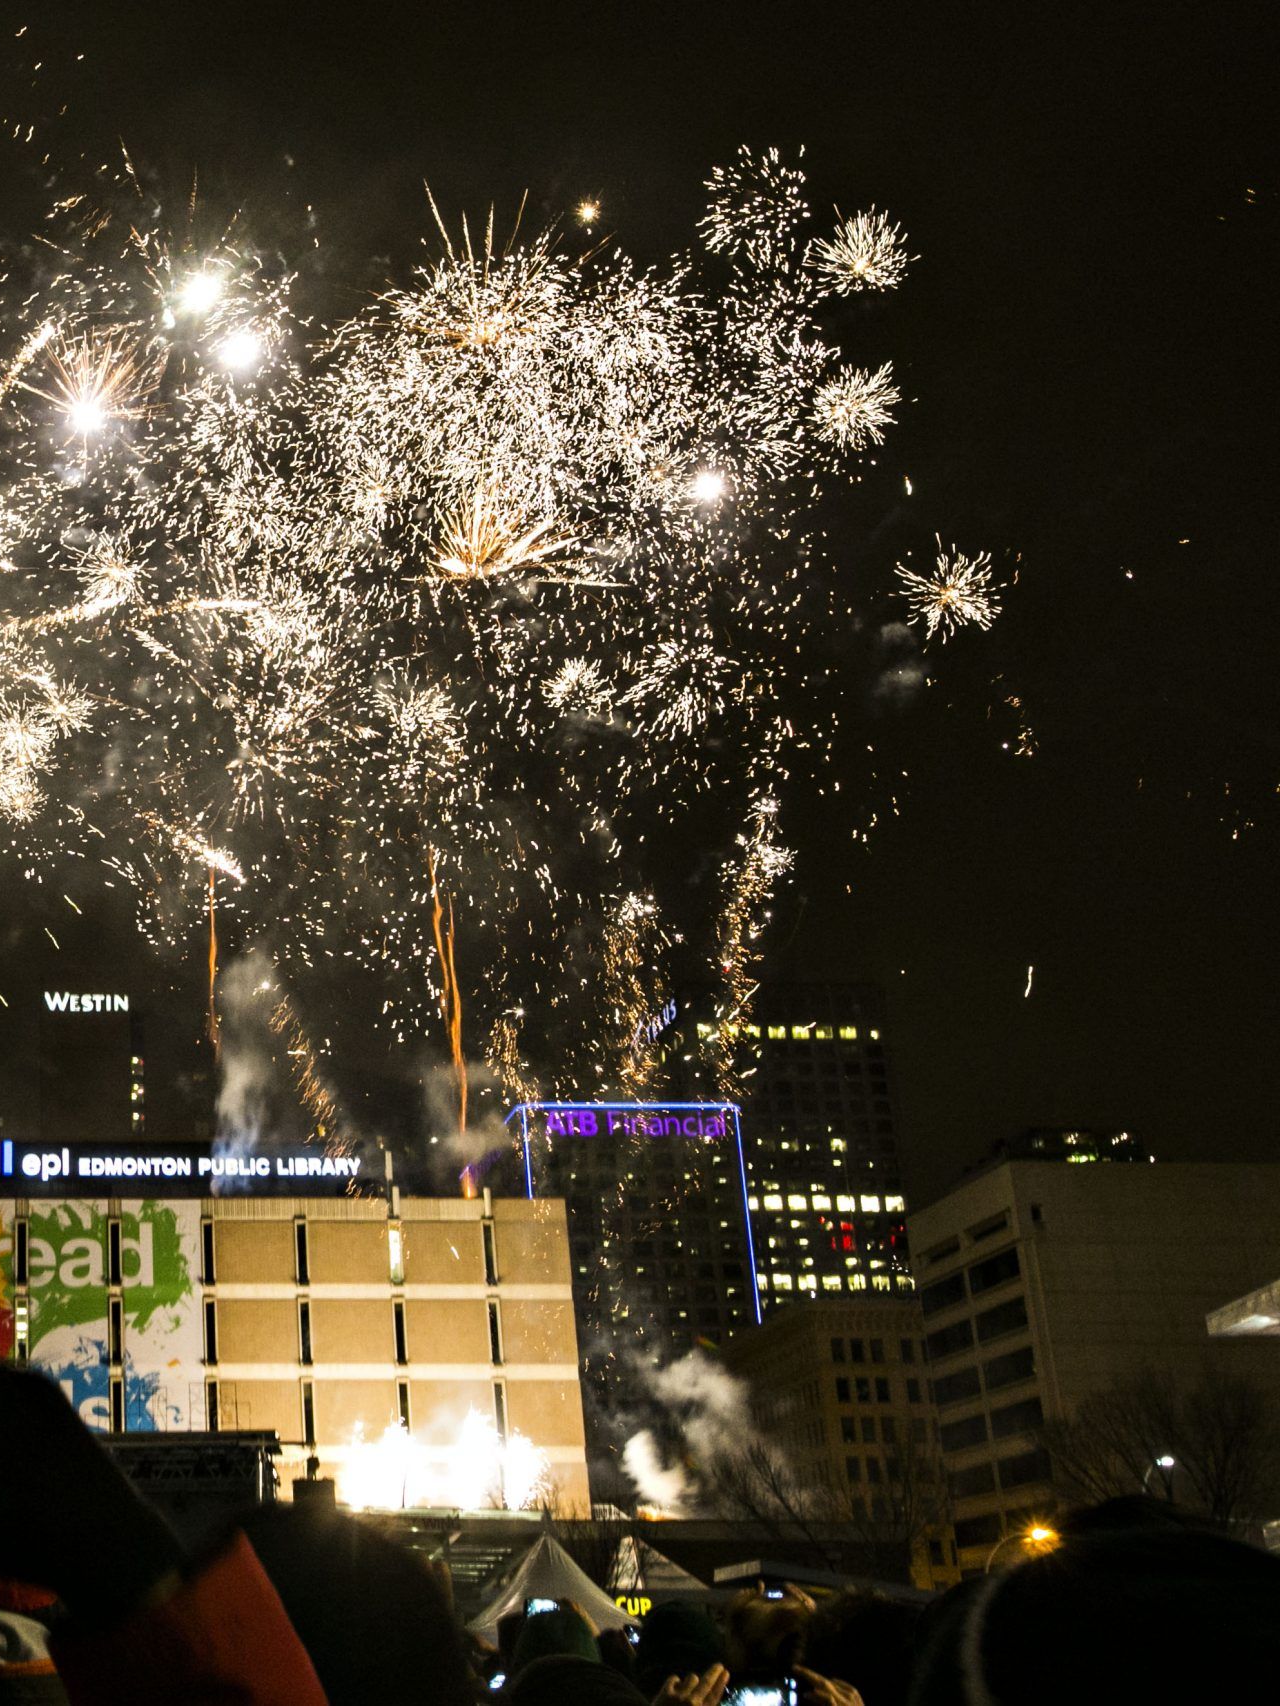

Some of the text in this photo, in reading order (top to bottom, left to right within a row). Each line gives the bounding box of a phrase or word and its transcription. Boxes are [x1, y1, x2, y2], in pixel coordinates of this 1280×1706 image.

[546, 1110, 726, 1137] ATB Financial
[22, 1147, 361, 1182] epl EDMONTON PUBLIC LIBRARY
[615, 1595, 652, 1617] CUP
